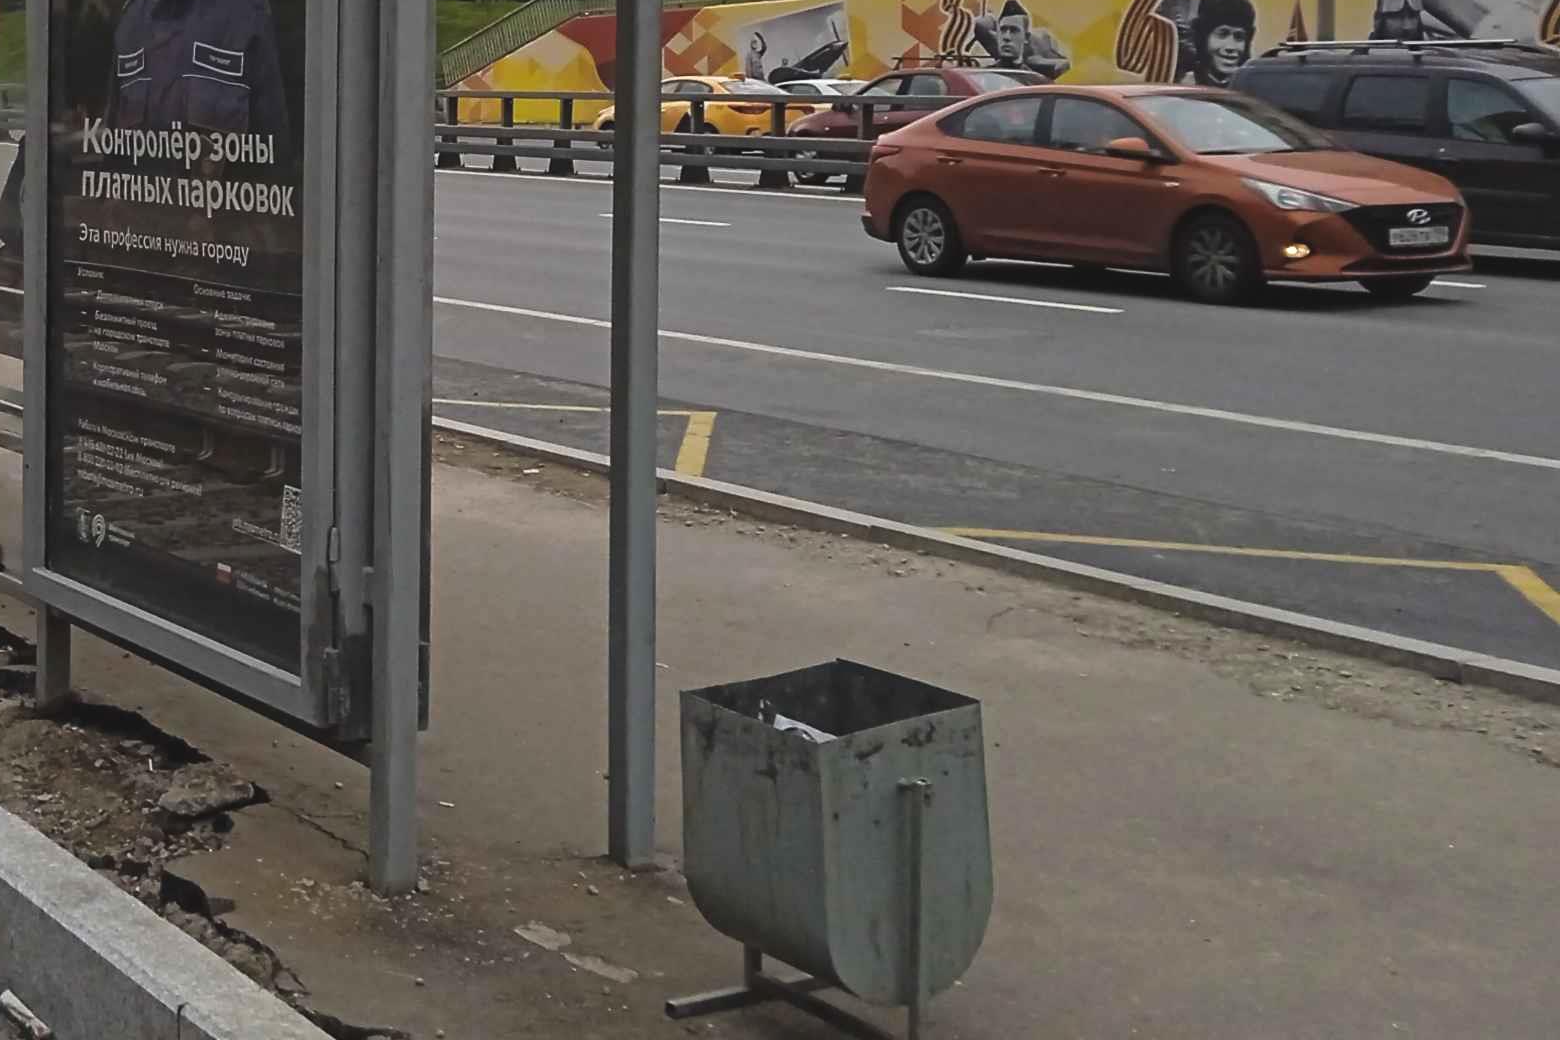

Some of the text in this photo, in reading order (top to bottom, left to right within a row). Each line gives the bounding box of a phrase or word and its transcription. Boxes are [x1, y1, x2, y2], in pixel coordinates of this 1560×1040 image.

[81, 117, 274, 169] Контролёр зоны
[81, 170, 295, 218] платных парковок
[79, 223, 249, 267] Эта профессия нужна городу
